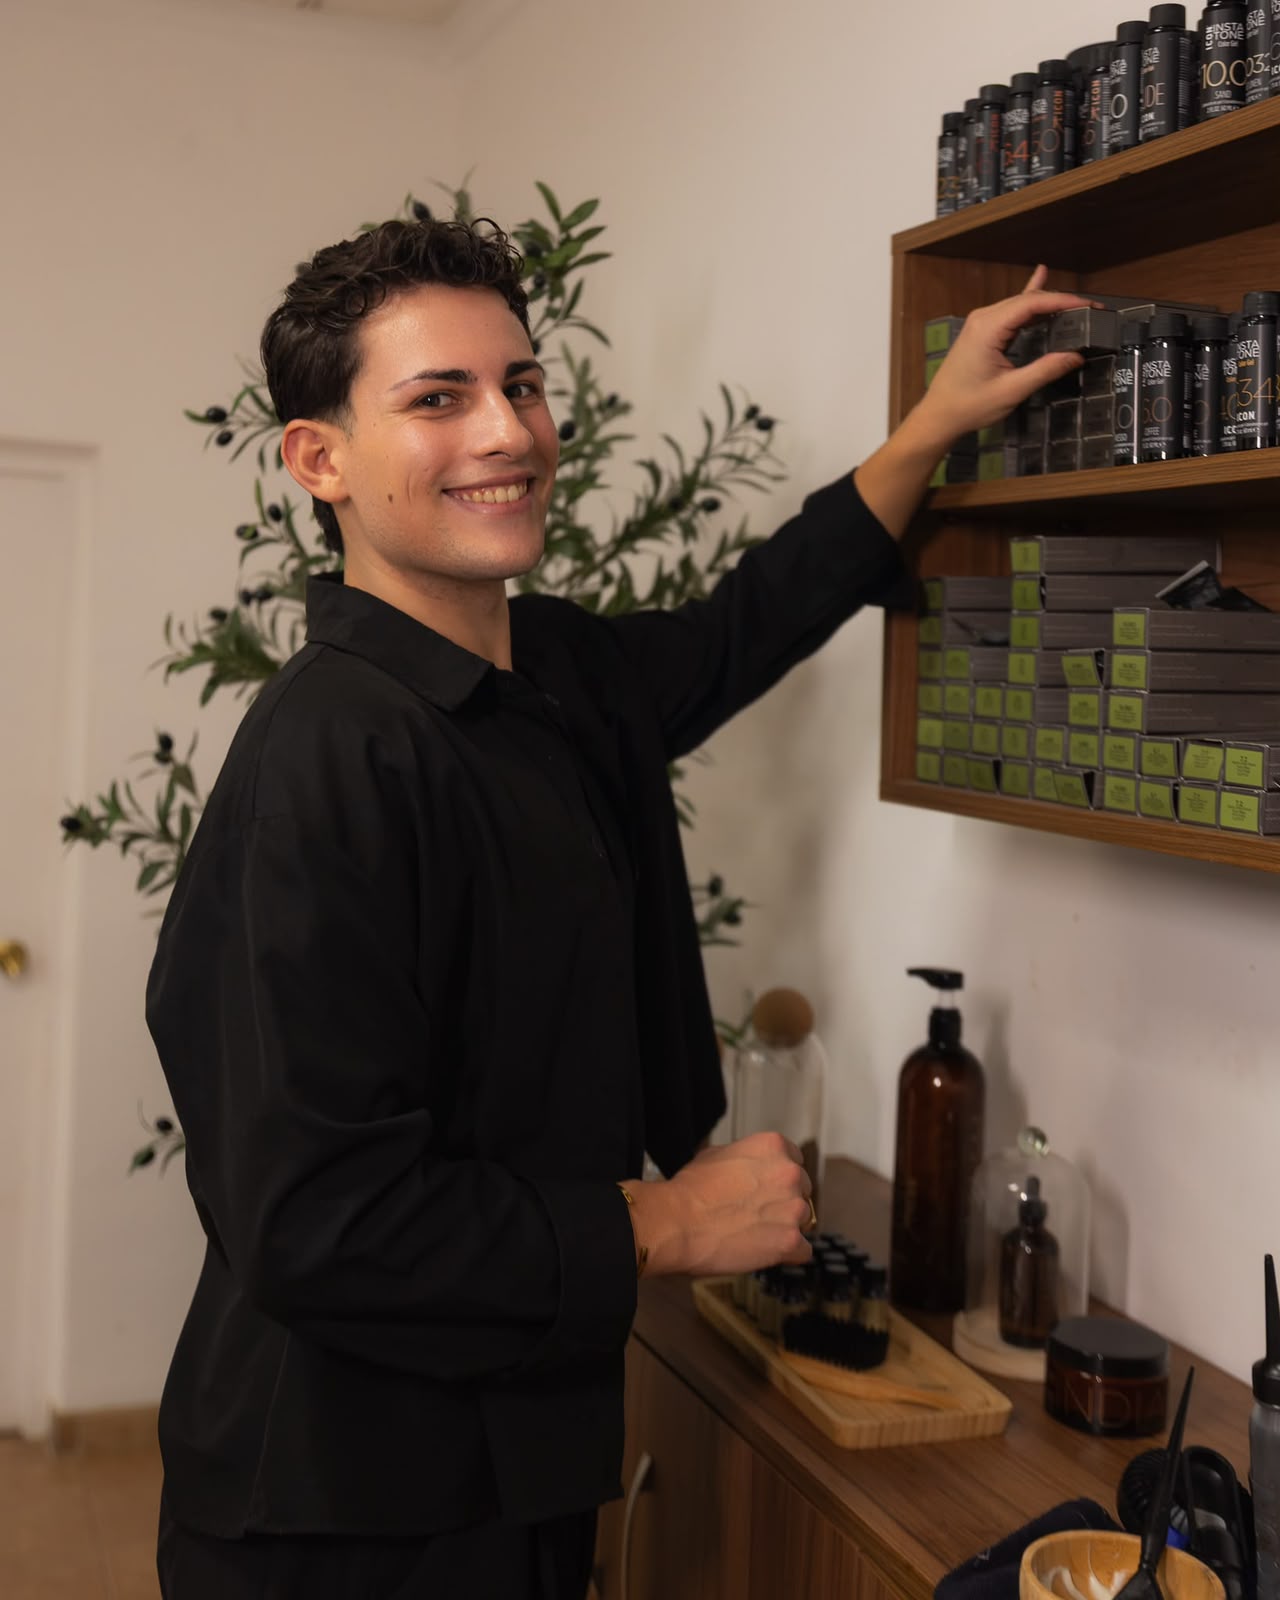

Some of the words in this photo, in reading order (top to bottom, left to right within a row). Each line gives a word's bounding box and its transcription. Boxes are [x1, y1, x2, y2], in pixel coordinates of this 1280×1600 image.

[1213, 22, 1244, 32] INSTA
[1214, 31, 1245, 41] TONE
[1201, 60, 1247, 89] 10.0
